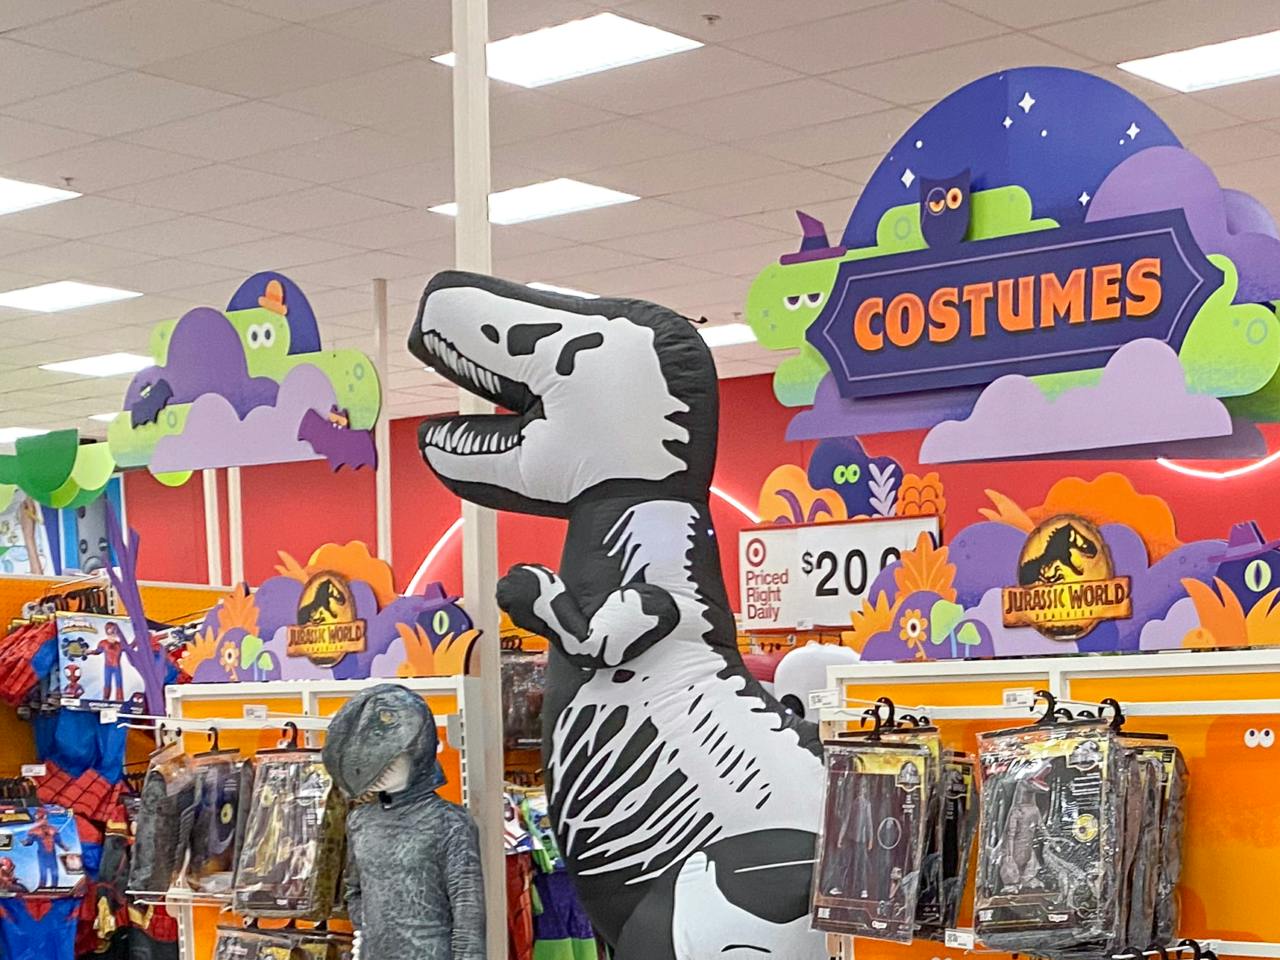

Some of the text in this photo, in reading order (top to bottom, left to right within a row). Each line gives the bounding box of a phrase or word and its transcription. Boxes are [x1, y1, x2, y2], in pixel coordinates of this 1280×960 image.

[854, 258, 1162, 350] COSTUMES
[746, 568, 789, 586] Priced
[747, 587, 782, 606] Right
[1006, 583, 1125, 614] JURASSIC WORLD
[747, 604, 780, 622] Daily
[328, 625, 362, 644] WORLD
